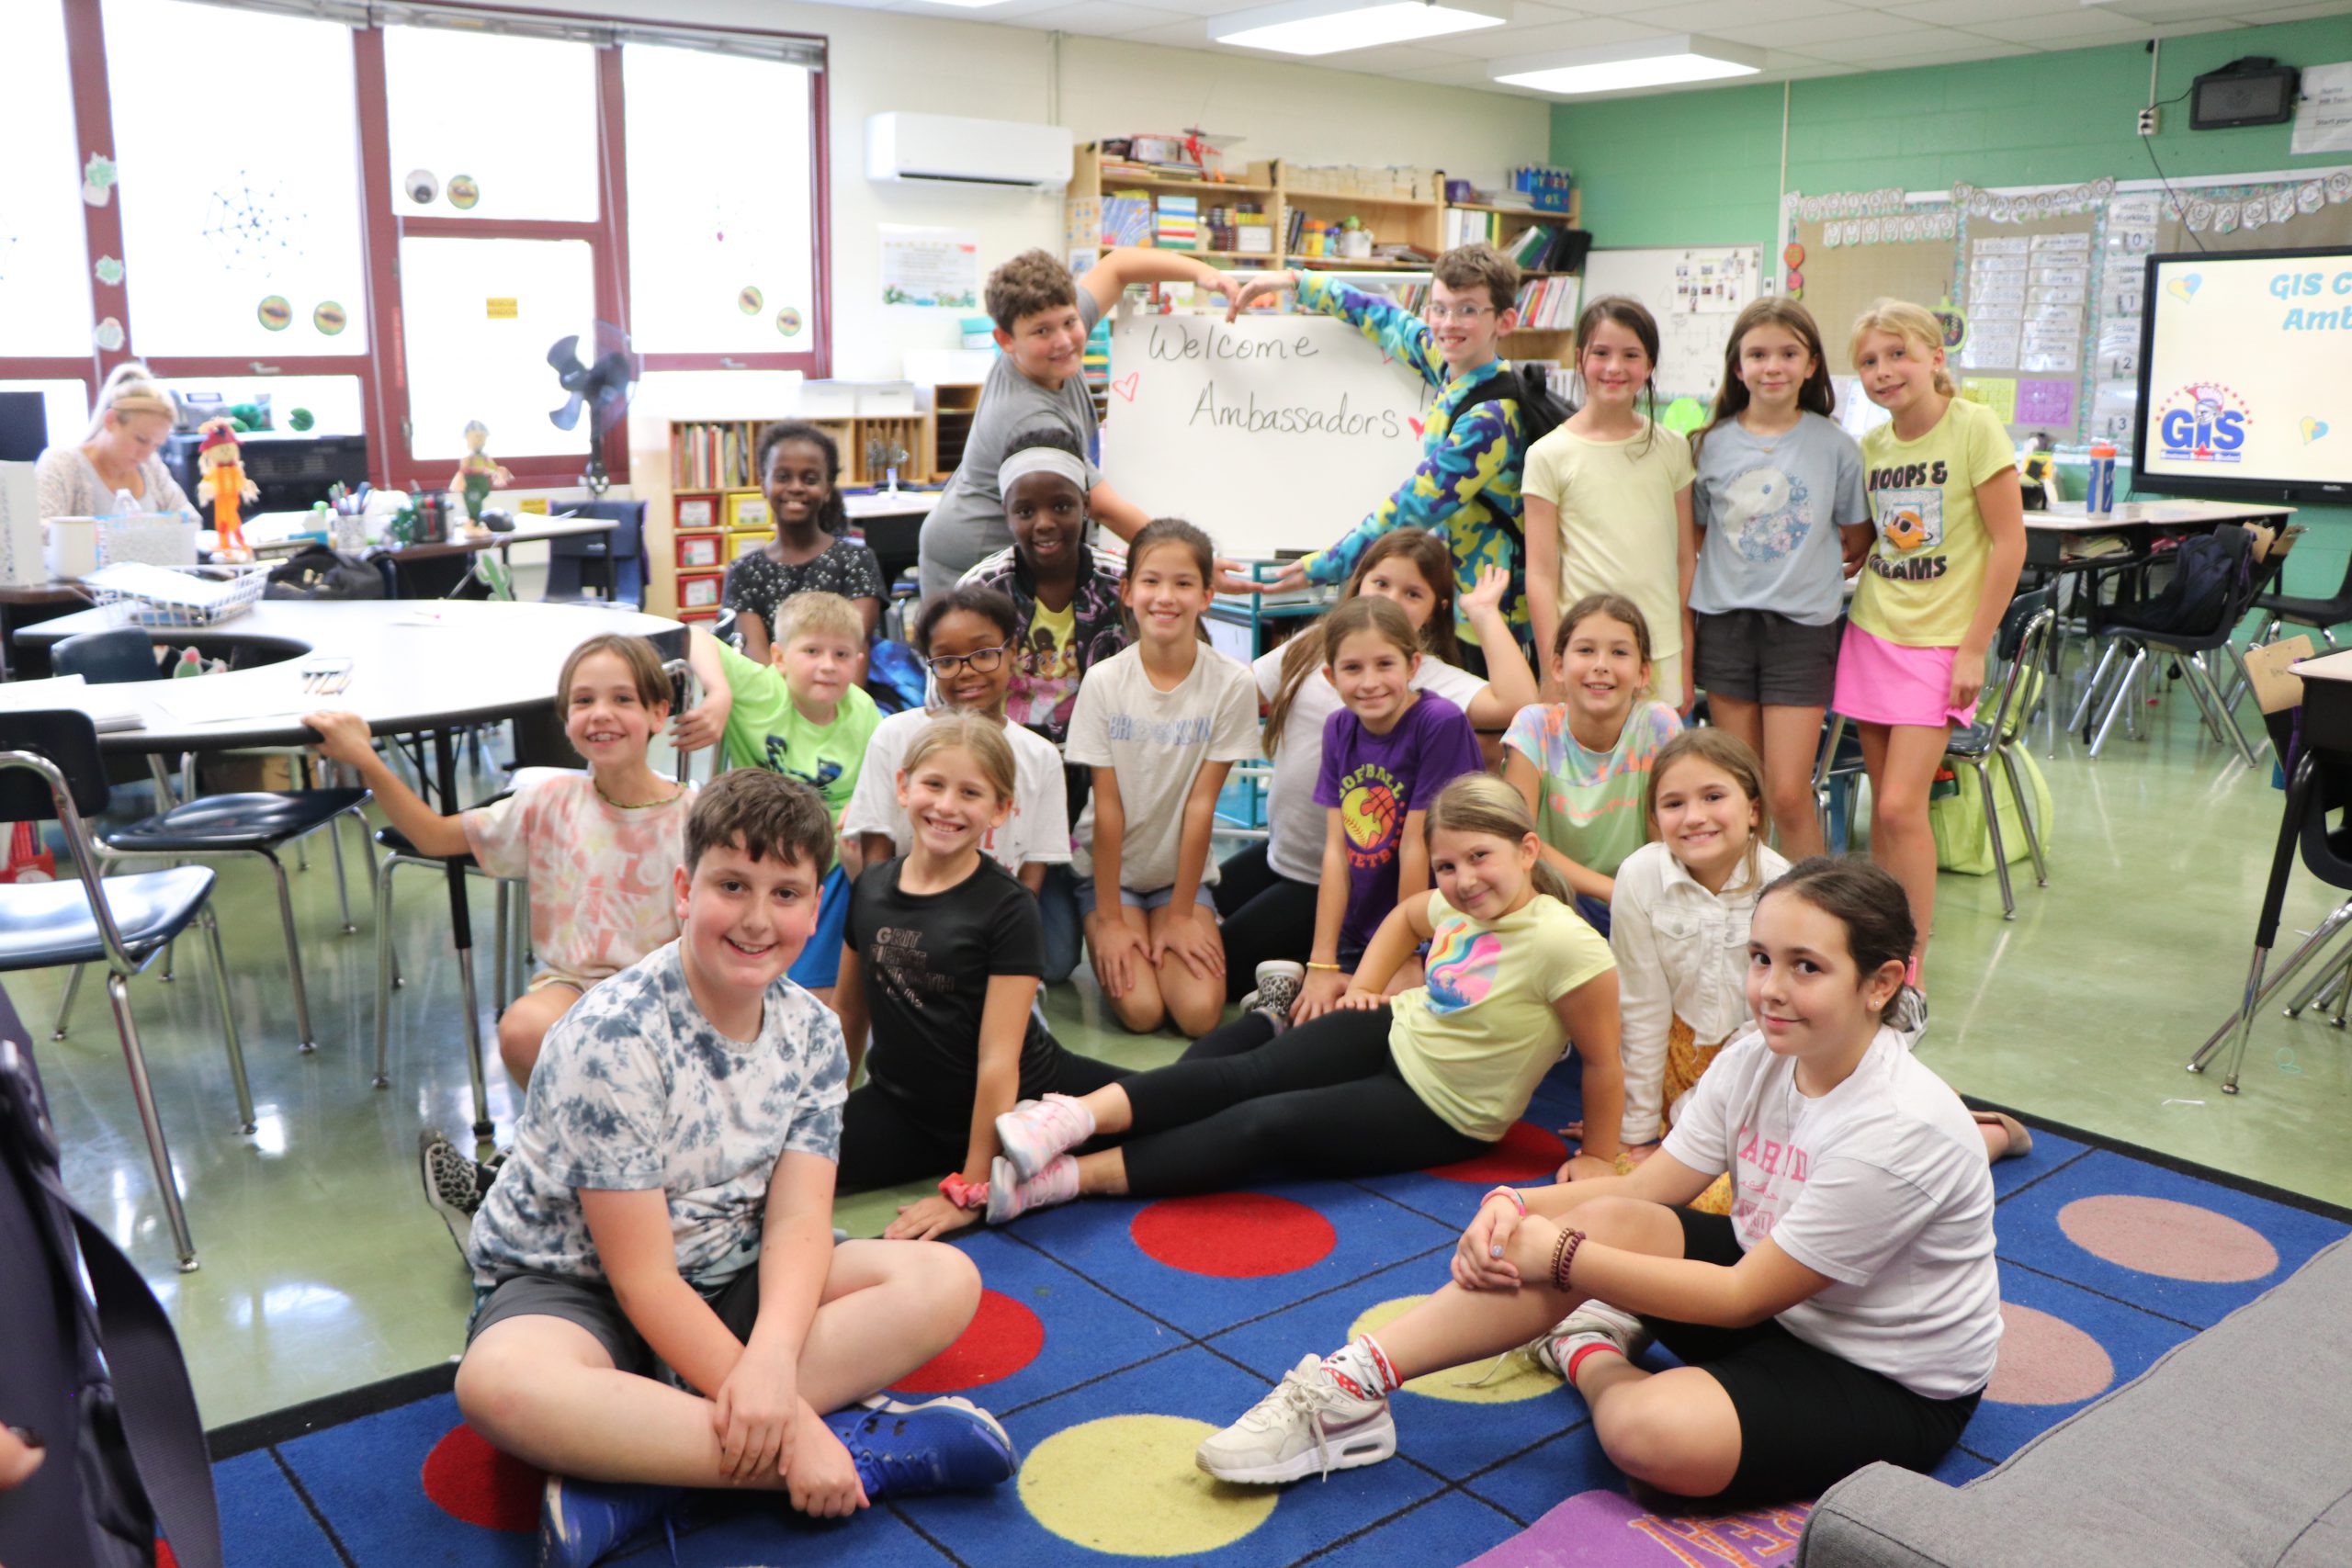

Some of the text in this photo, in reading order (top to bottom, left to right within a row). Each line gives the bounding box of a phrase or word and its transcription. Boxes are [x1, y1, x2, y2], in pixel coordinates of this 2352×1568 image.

[1828, 215, 1953, 237] STUDIES
[2269, 273, 2324, 299] GIS
[1148, 324, 1319, 361] Welcome
[2123, 357, 2132, 369] 2
[1189, 379, 1400, 438] Ambassadors
[2161, 408, 2245, 450] GIS
[1869, 460, 1948, 491] HOOPS &
[876, 926, 923, 949] GRIT
